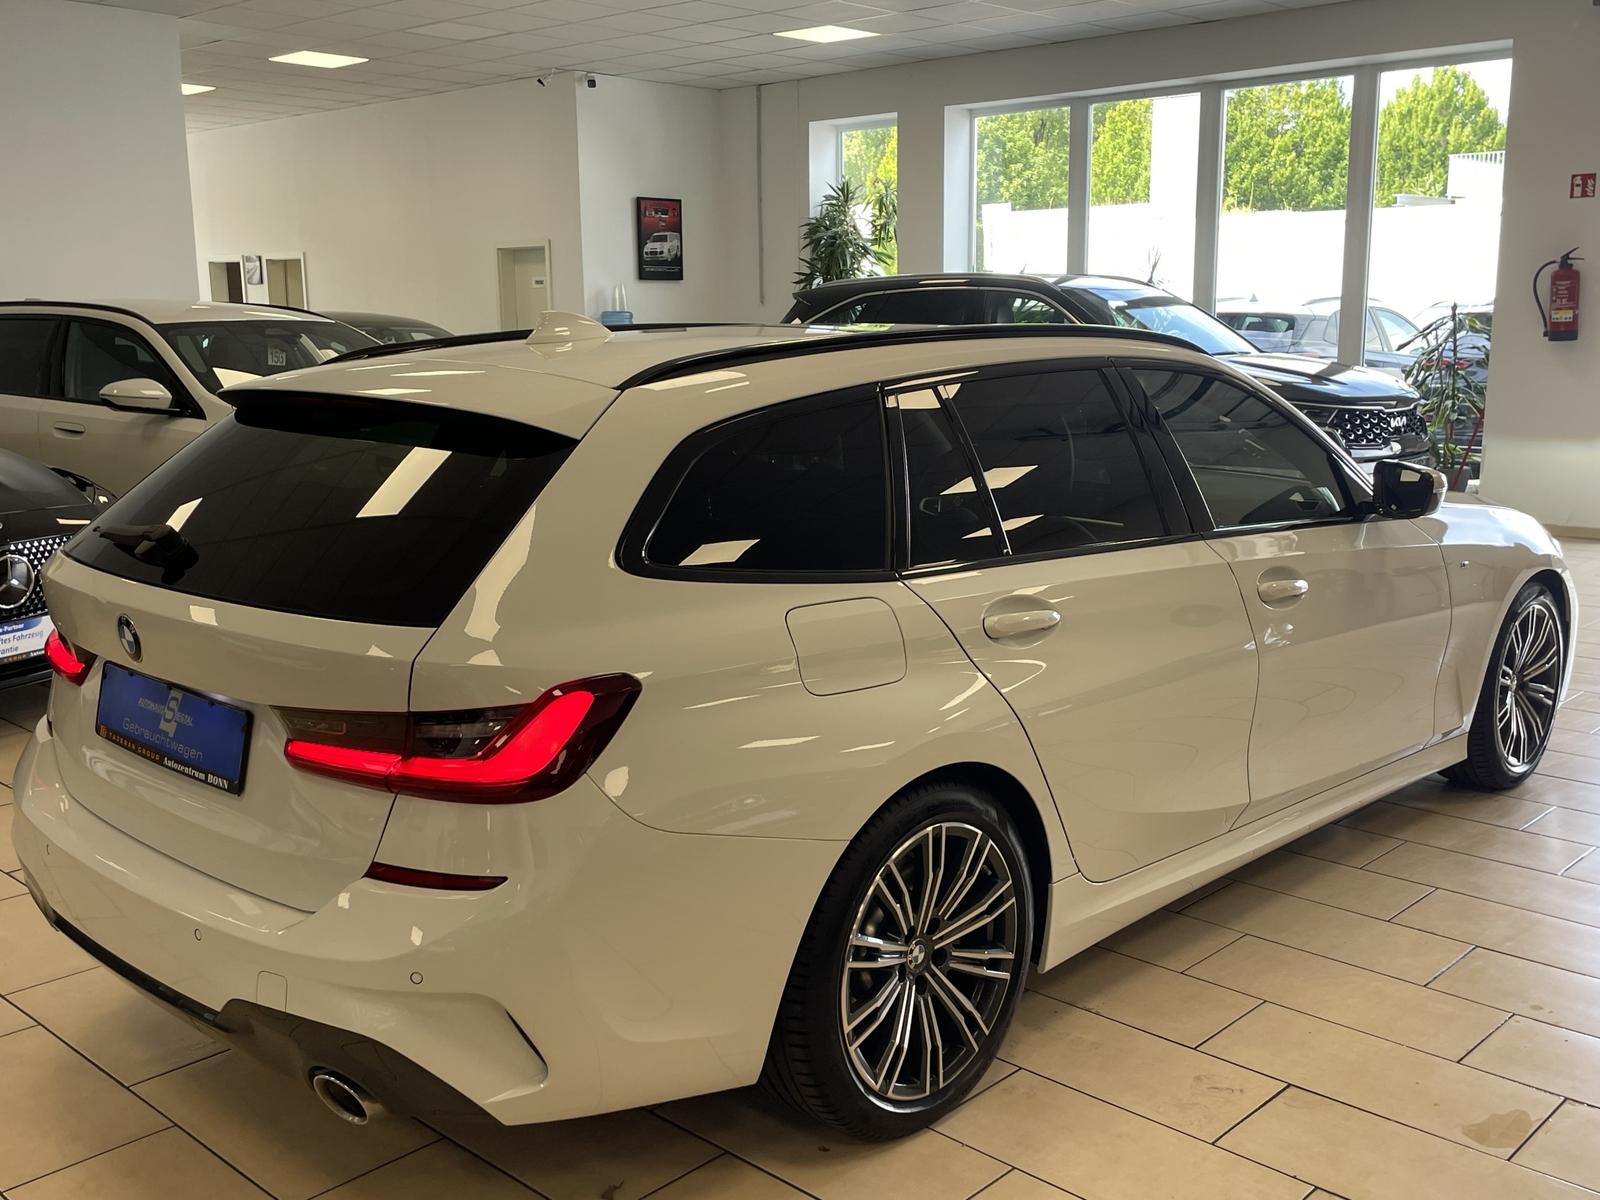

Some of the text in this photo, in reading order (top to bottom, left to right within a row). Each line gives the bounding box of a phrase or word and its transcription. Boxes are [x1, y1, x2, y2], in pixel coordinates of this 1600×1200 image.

[12, 630, 44, 642] Fahrzeug
[122, 717, 204, 761] Gebrauchtwagen
[163, 756, 205, 781] Autozentrum
[207, 770, 230, 790] BONN
